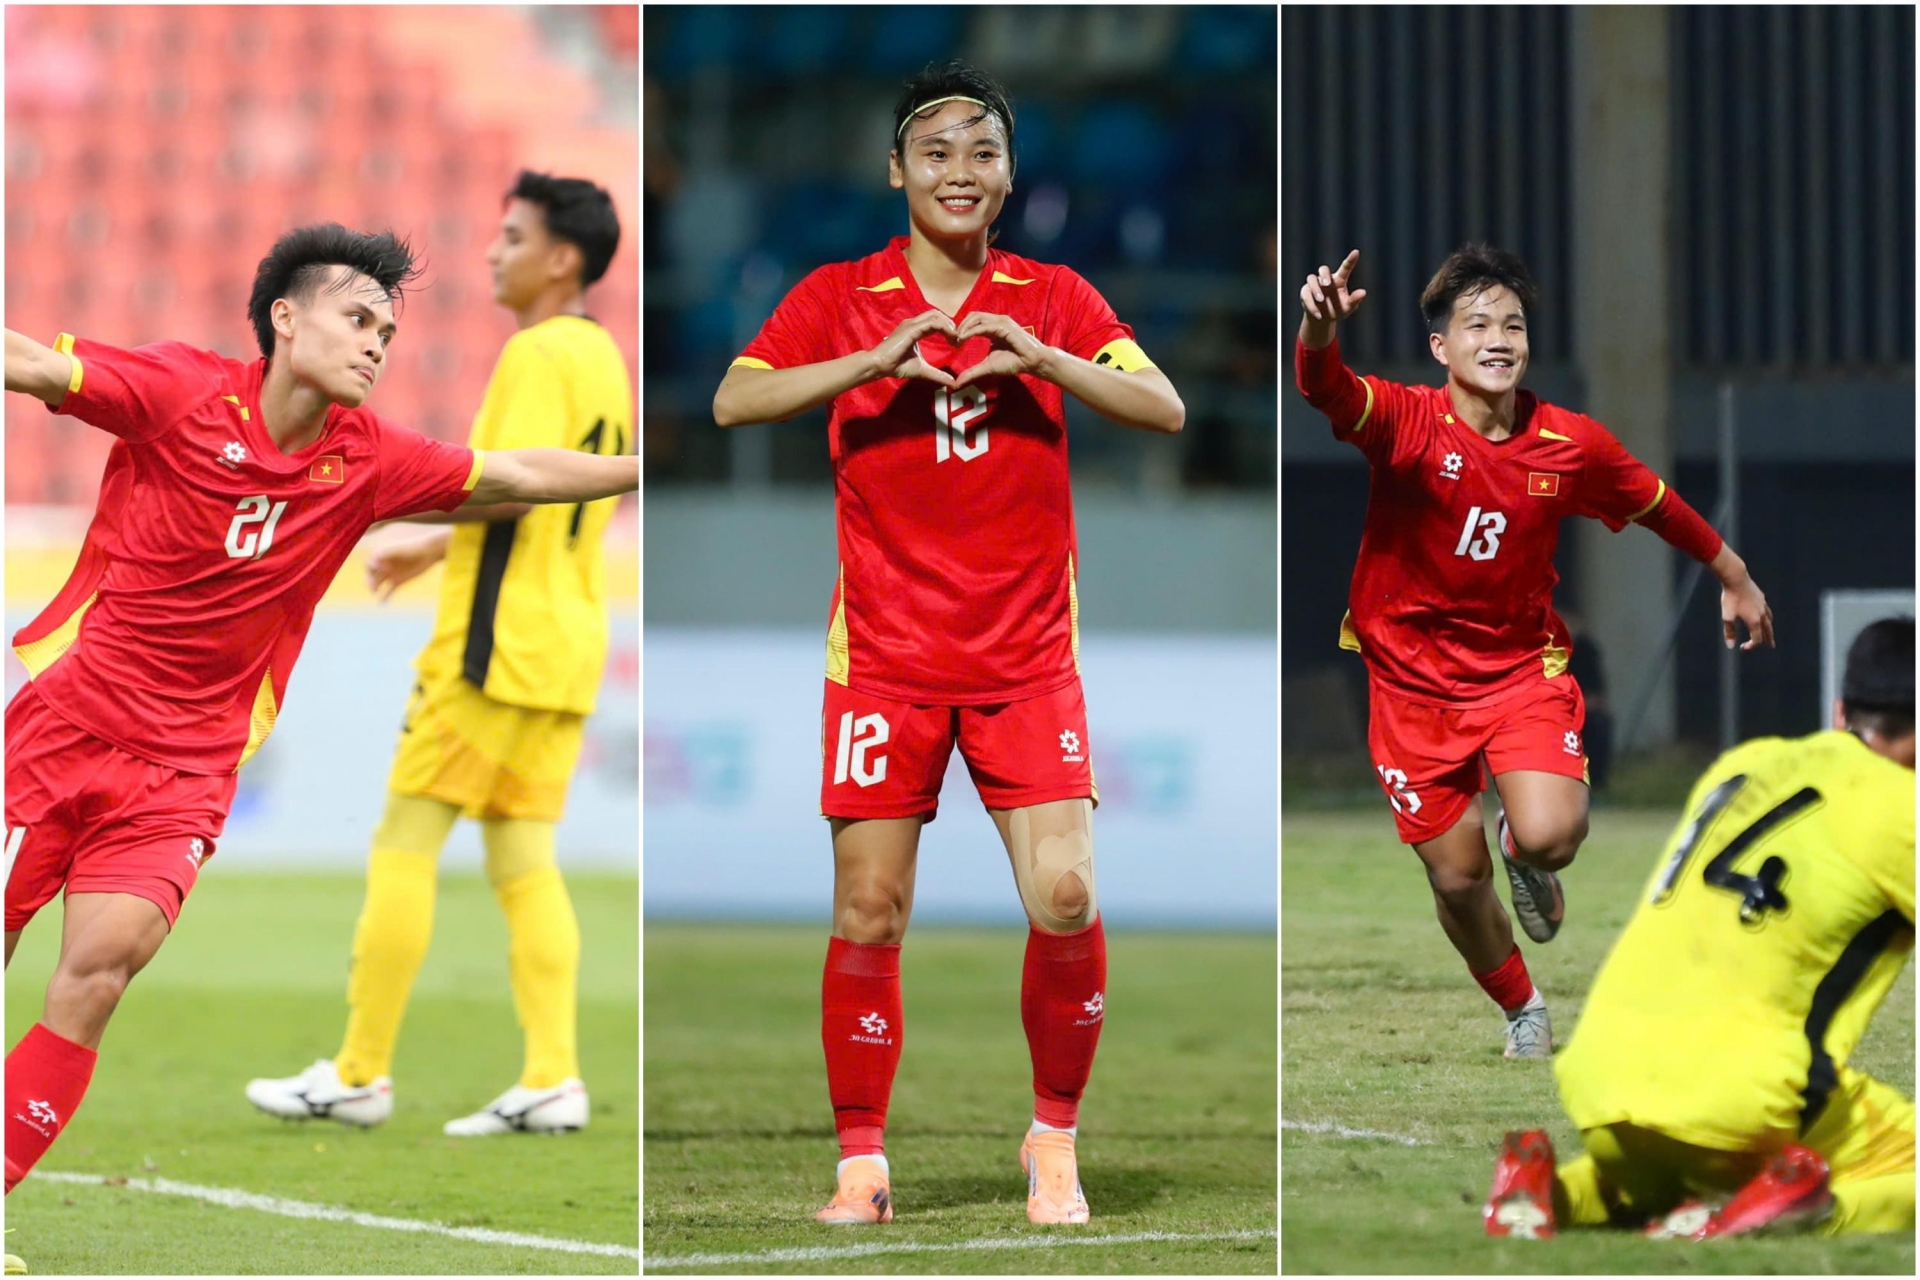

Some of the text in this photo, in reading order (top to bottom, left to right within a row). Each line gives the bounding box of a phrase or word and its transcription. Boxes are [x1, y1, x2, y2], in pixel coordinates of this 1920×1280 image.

[934, 384, 989, 464] 12
[224, 494, 288, 561] 21
[1454, 506, 1508, 561] 13
[833, 710, 890, 788] 12
[1652, 774, 1824, 928] 14
